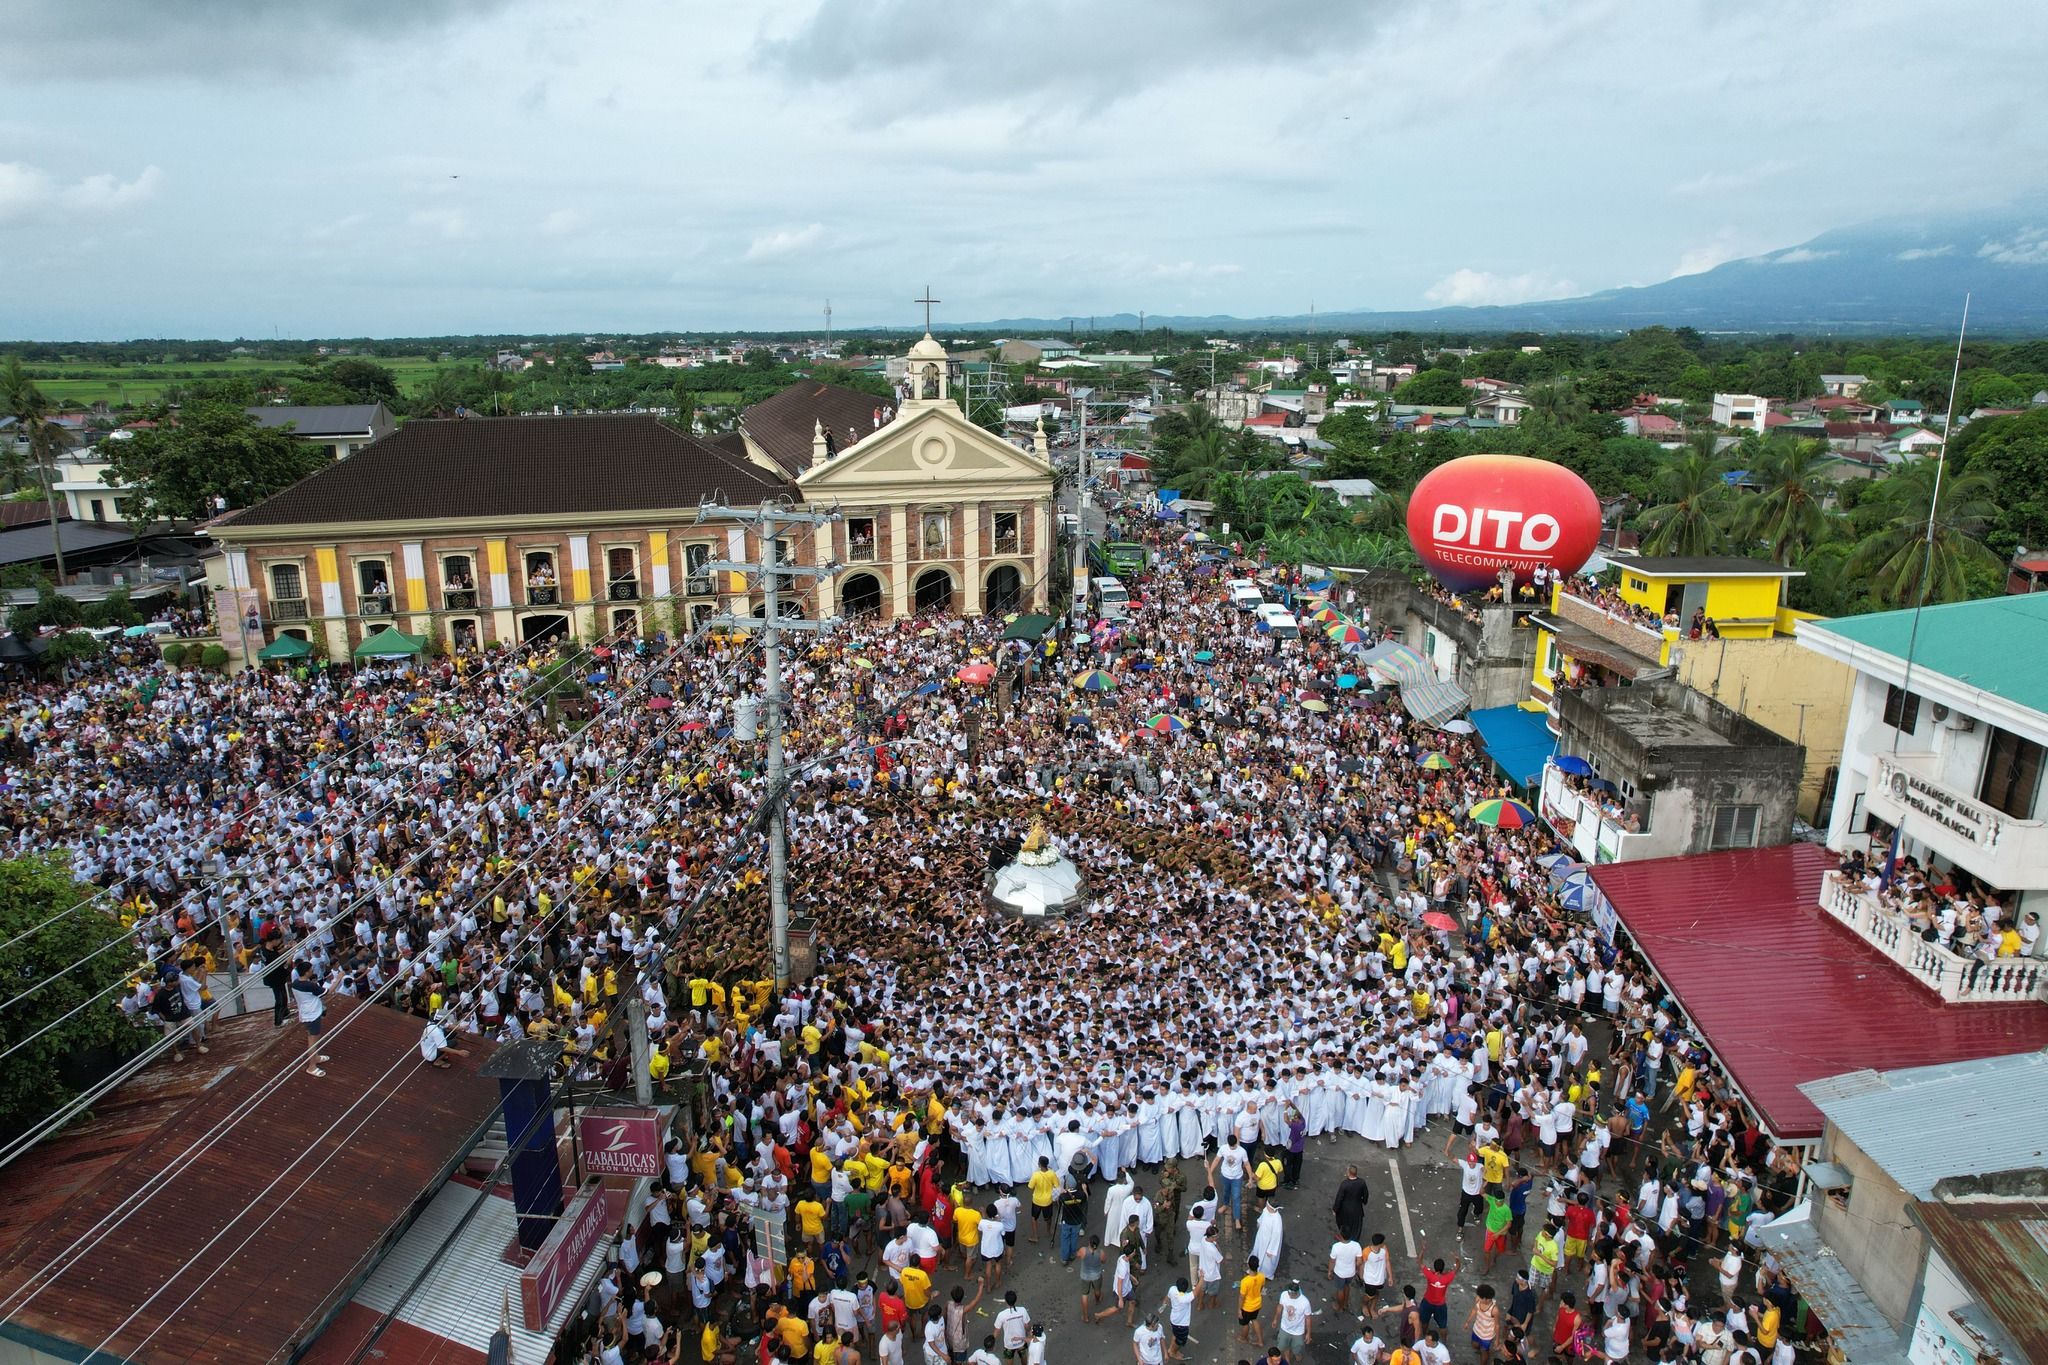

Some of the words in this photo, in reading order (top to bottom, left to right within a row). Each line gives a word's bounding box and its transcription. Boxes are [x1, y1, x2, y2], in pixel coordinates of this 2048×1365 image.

[1433, 504, 1560, 551] DITO
[1435, 550, 1550, 570] TELECOMMUNITY
[1904, 794, 1976, 842] PEÑAFRANCIA
[585, 1150, 656, 1168] ZABALDICA'S
[587, 1164, 618, 1172] LITSON
